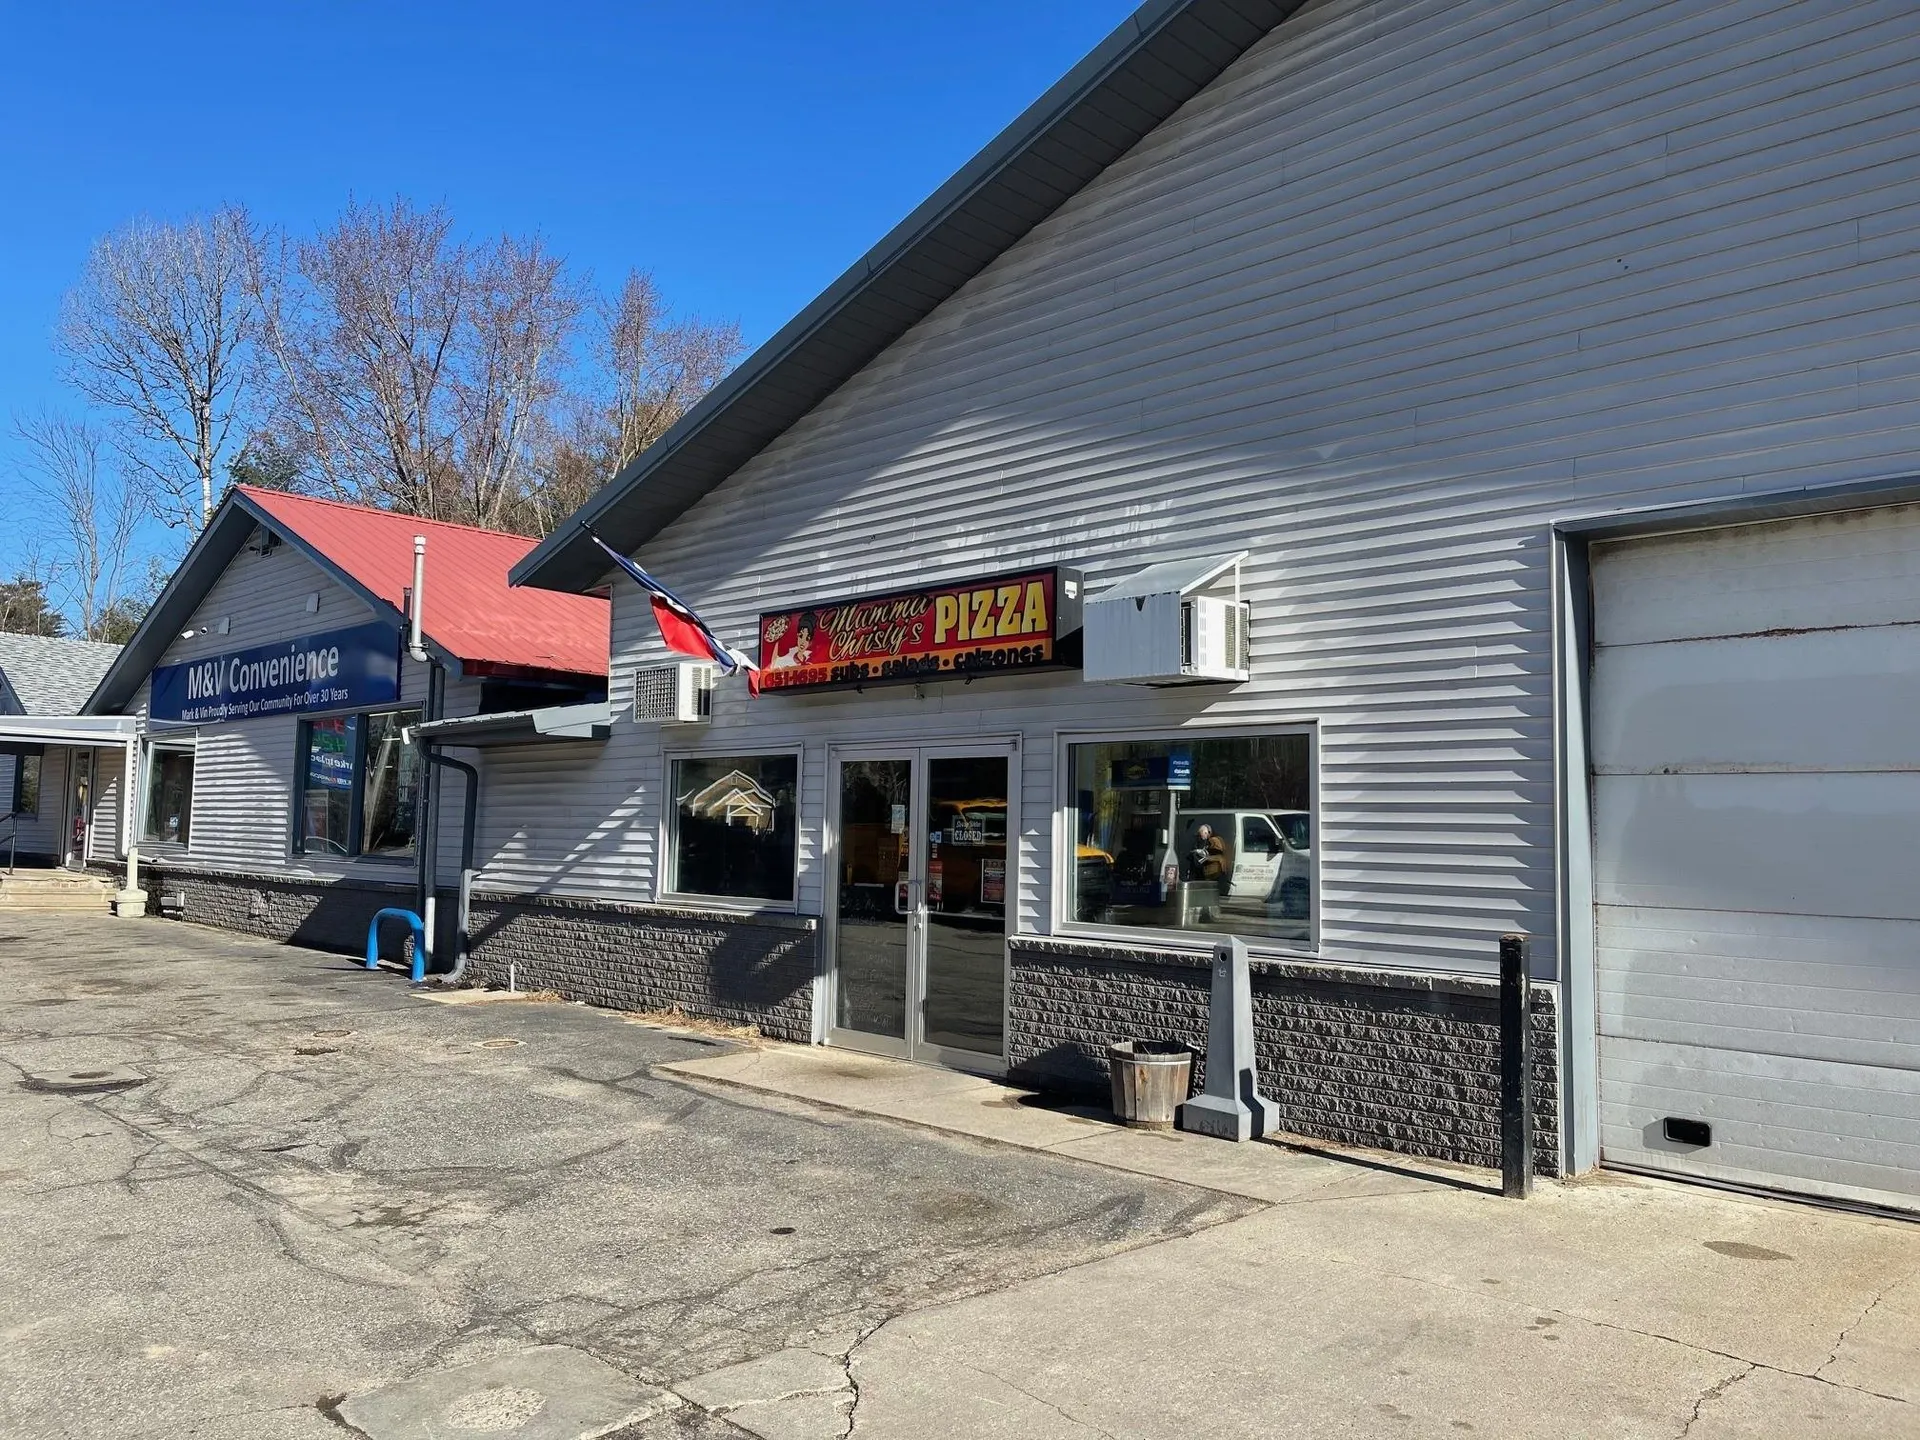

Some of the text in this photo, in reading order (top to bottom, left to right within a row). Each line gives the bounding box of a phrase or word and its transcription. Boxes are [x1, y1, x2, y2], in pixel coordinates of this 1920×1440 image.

[934, 582, 1048, 644] PIZZA
[187, 643, 339, 700] M&V Convenience
[831, 661, 869, 681] subs
[882, 653, 940, 678] salads
[953, 644, 1043, 669] calzones
[181, 687, 348, 720] Mark & Vin Proudly Serving Our Community For Over 30 Years
[955, 830, 982, 841] CLOSED
